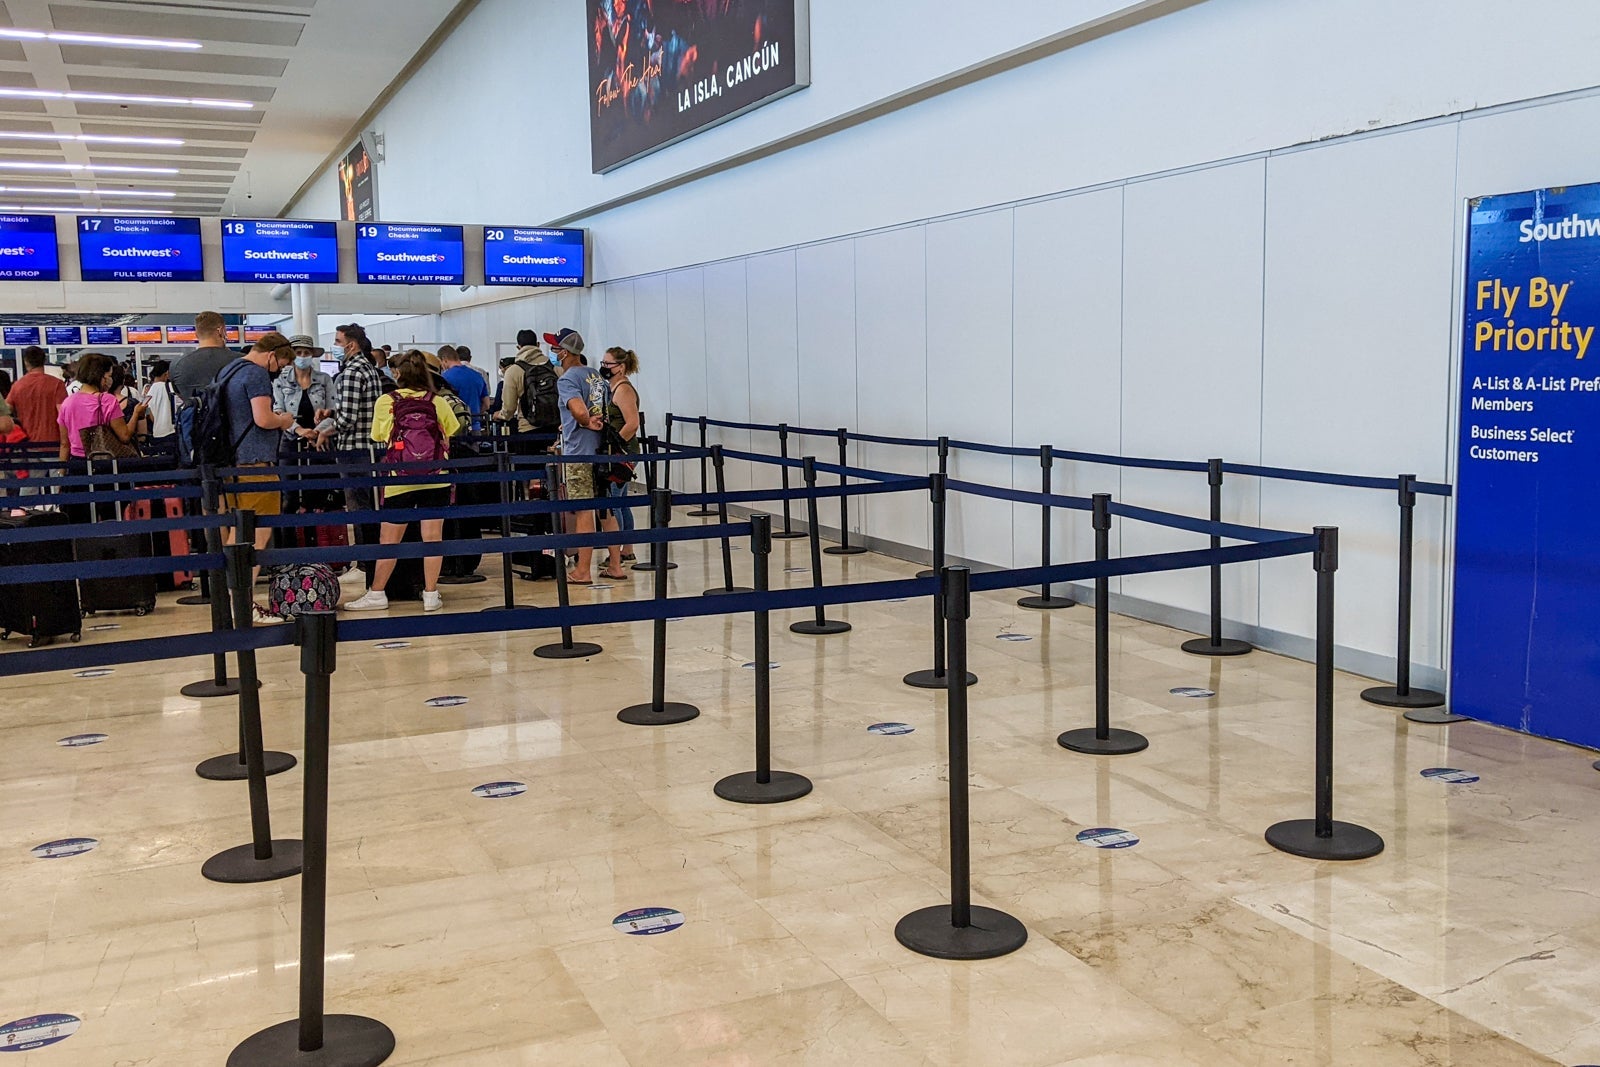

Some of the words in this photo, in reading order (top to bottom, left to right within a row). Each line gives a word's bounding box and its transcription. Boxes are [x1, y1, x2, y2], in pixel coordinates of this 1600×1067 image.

[620, 61, 639, 89] The
[639, 45, 664, 93] Heat
[678, 88, 691, 113] LA
[694, 74, 723, 105] ISLA,
[726, 40, 780, 88] CANCÚN
[81, 219, 101, 231] 17
[113, 218, 175, 226] Documentación
[225, 223, 245, 234] 18
[359, 226, 378, 237] 19
[388, 225, 442, 233] Documentación
[486, 230, 504, 240] 20
[102, 247, 171, 257] Southwest
[244, 250, 309, 260] Southwest
[376, 252, 437, 262] Southwest
[502, 255, 559, 265] Southwest
[1476, 278, 1521, 319] Fly
[1528, 276, 1570, 317] By
[1474, 318, 1595, 360] Priority
[1472, 376, 1510, 391] A-List
[1512, 376, 1523, 391] &
[1525, 376, 1566, 391] A-List
[1570, 376, 1600, 392] Pref
[1471, 396, 1534, 412] Members
[1471, 425, 1527, 441] Business
[1529, 427, 1574, 443] Select
[1469, 445, 1539, 463] Customers
